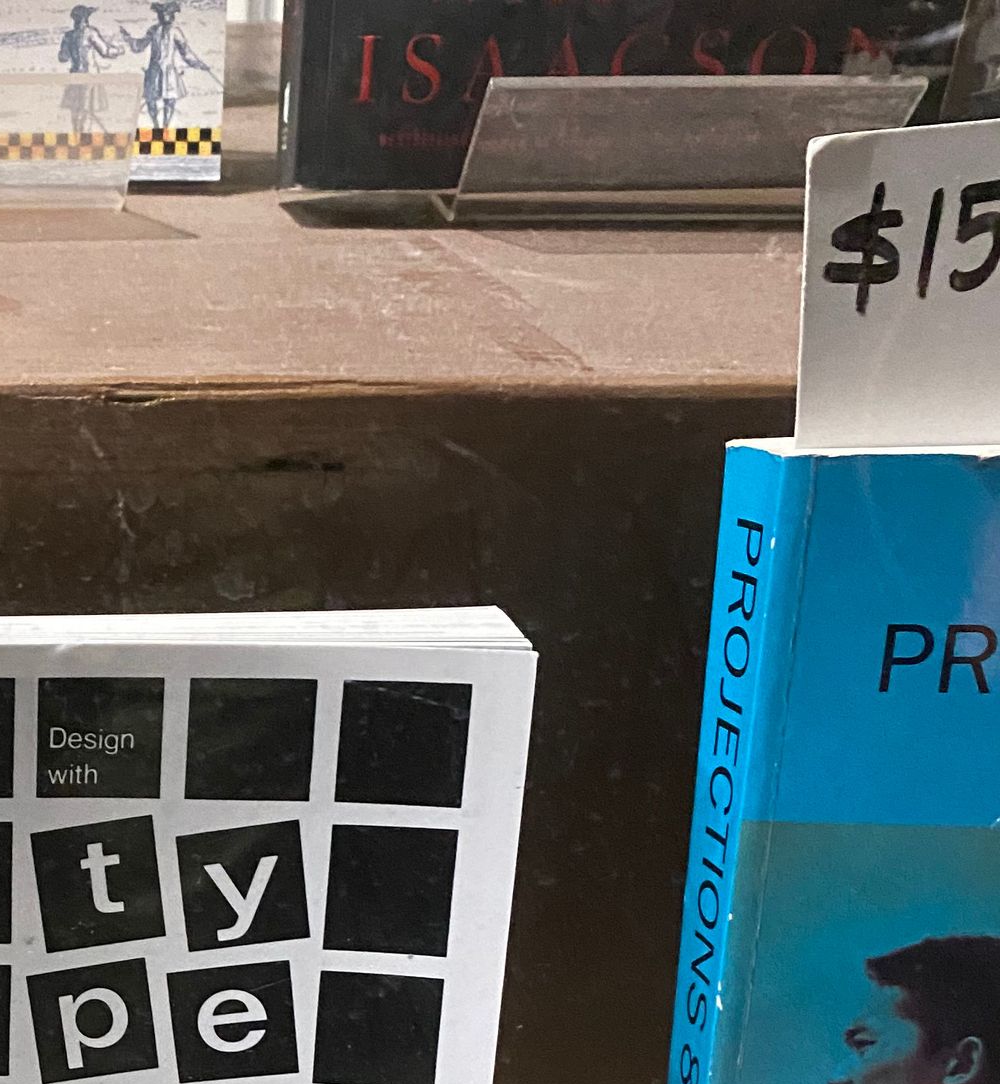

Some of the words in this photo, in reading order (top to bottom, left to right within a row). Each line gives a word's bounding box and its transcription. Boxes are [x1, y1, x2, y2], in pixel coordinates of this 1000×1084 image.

[878, 623, 998, 694] PR
[49, 726, 136, 756] Design
[47, 763, 99, 785] with
[685, 517, 765, 1033] PROJECTIONS
